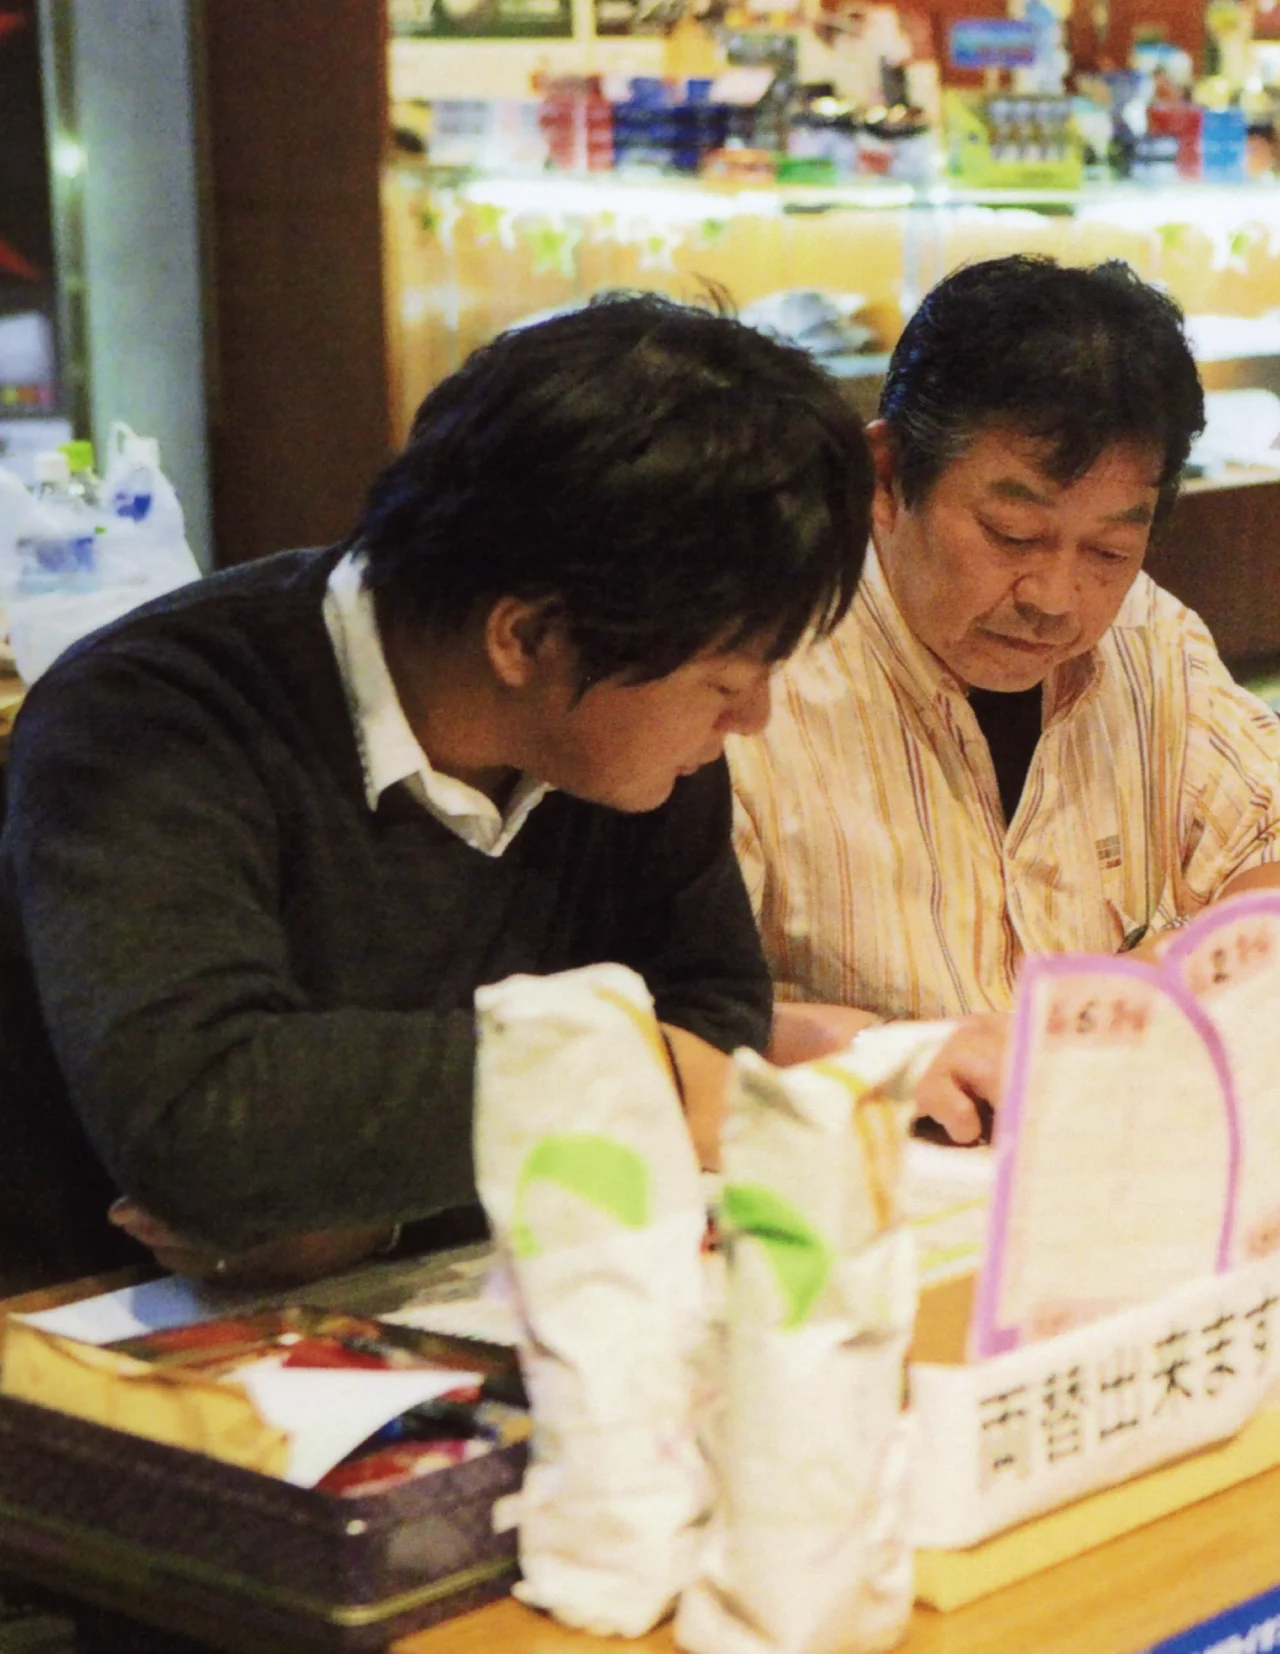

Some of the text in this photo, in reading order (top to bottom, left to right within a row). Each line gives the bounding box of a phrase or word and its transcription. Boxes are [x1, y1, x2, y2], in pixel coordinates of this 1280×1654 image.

[978, 1296, 1279, 1482] 両替出来ます
